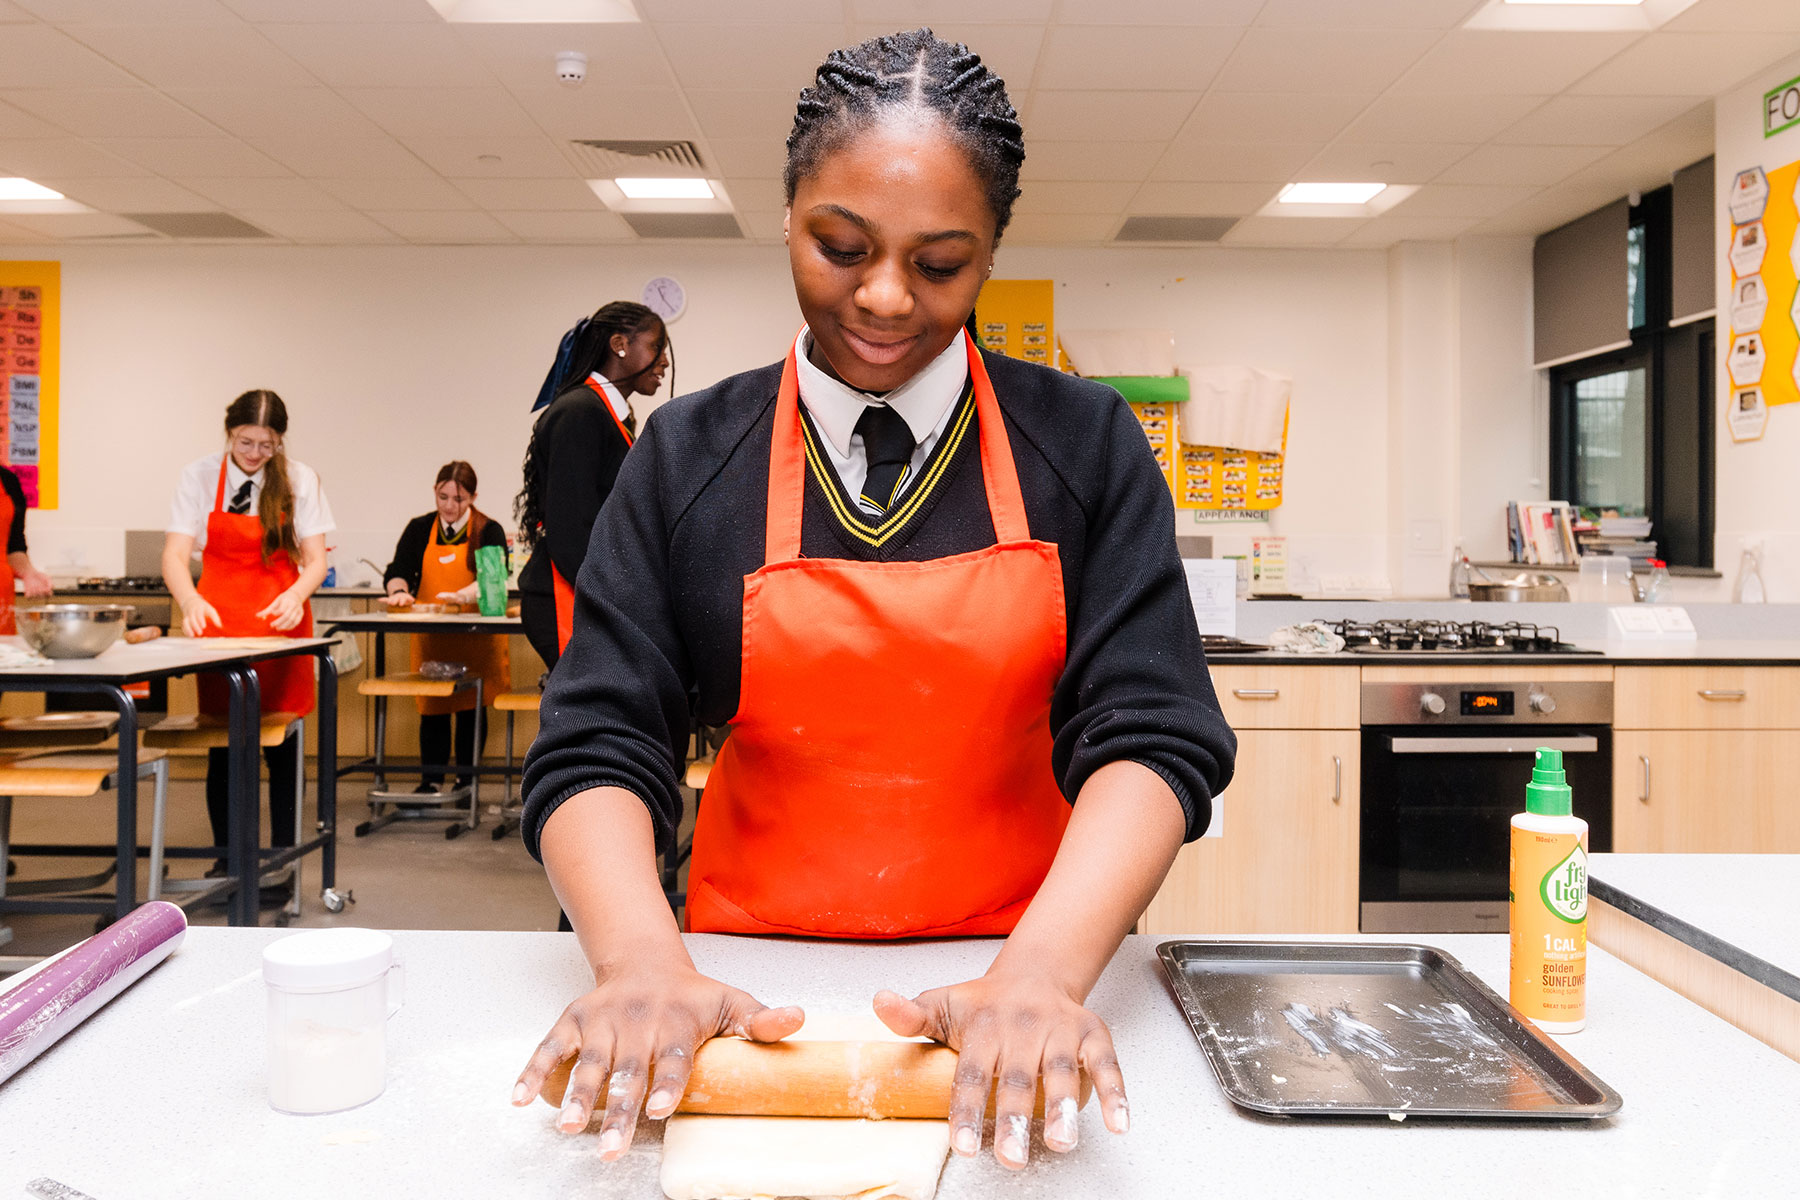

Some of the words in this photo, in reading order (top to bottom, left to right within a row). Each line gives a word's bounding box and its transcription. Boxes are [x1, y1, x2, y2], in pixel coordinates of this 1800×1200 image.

[1566, 861, 1586, 887] fry
[1543, 933, 1551, 951] 1
[1553, 938, 1577, 952] CAL
[1543, 952, 1569, 961] nothing
[1542, 963, 1574, 974] golden
[1543, 987, 1565, 995] cooking
